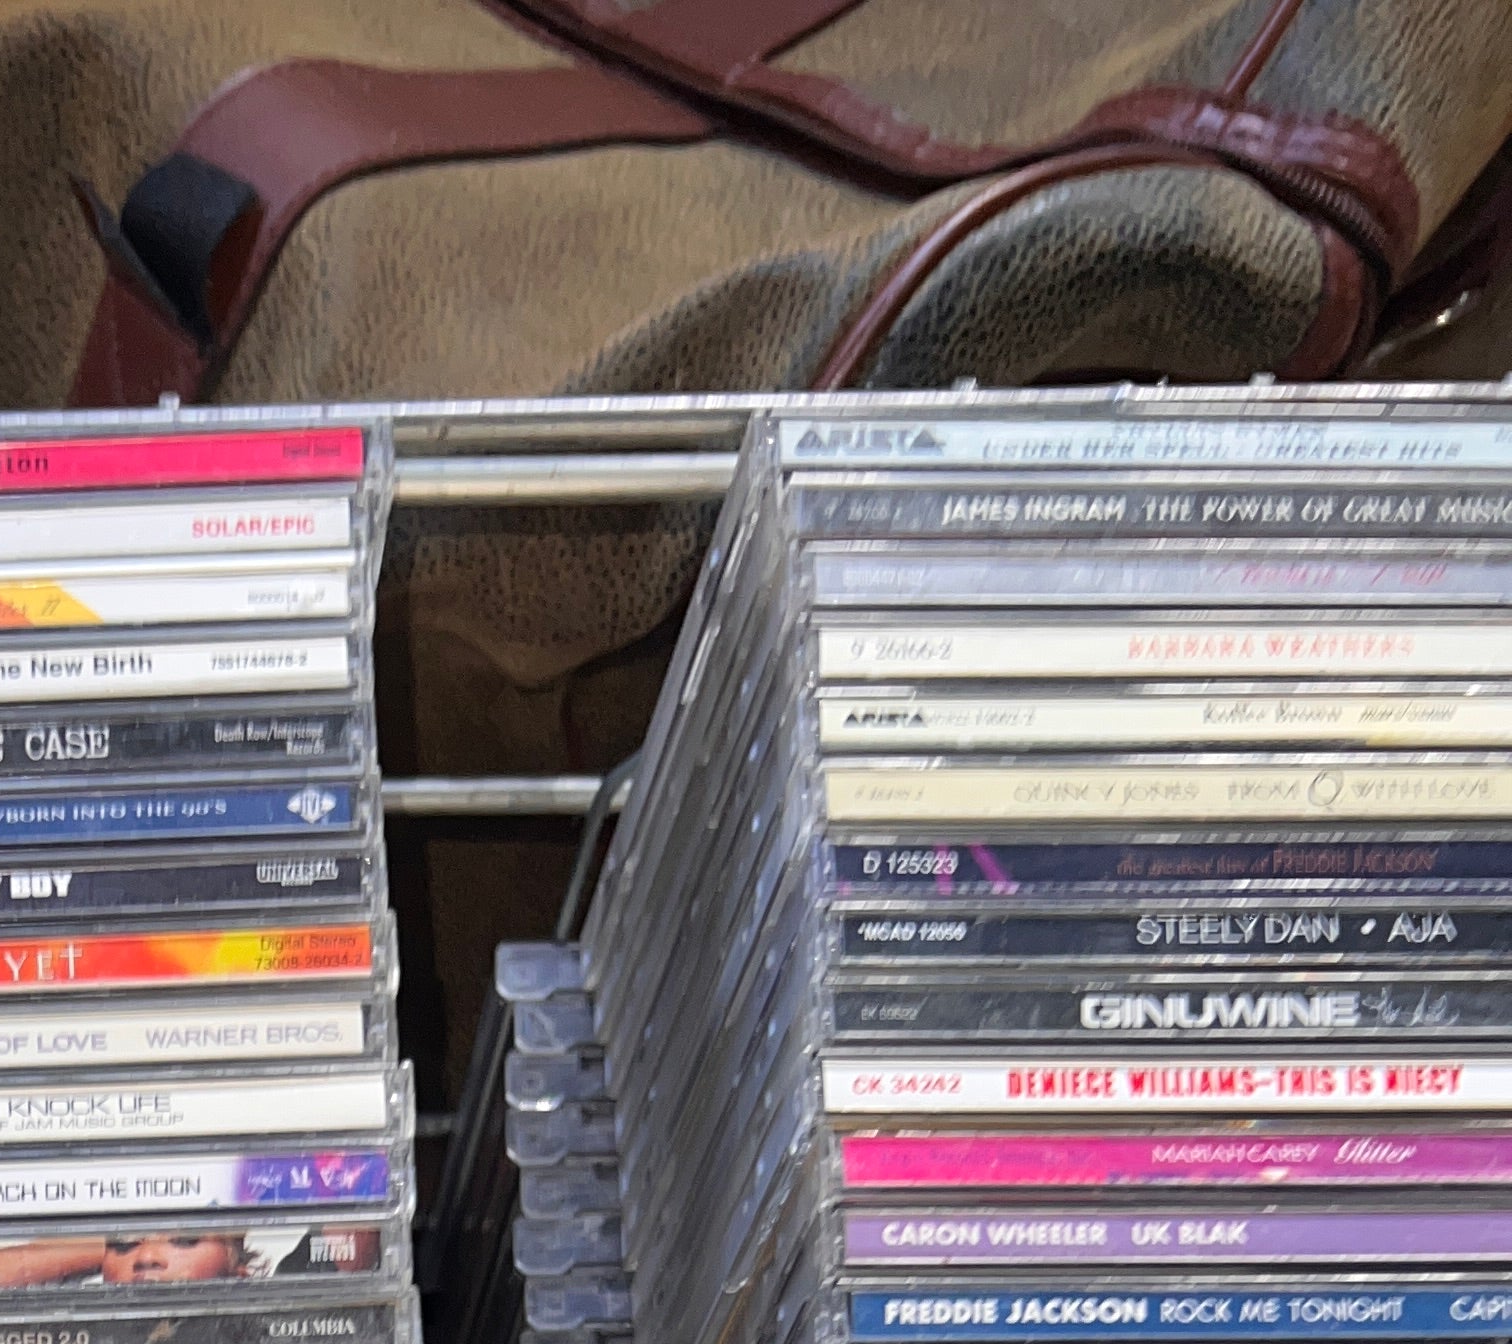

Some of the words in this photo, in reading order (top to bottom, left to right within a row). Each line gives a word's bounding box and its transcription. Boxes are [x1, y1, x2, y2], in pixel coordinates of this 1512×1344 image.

[191, 515, 316, 539] SOLAR/EPIC
[30, 655, 82, 679] New
[93, 652, 153, 676] Birth
[24, 726, 111, 761] CASE
[10, 870, 74, 898] BOY
[1135, 914, 1261, 945] STEELY
[1265, 913, 1340, 944] DAN
[1388, 912, 1458, 944] AJA
[1079, 990, 1361, 1030] GINUWINE
[36, 1032, 108, 1053] LOVE
[881, 1222, 980, 1247] CARON
[987, 1222, 1107, 1246] WHEELER
[1131, 1221, 1172, 1246] UK
[1178, 1221, 1250, 1245] BLAK
[884, 1299, 999, 1325] FREDDIE
[1005, 1299, 1147, 1324] JACKSON
[1160, 1299, 1232, 1323] ROCK
[1239, 1298, 1279, 1323] ME
[1287, 1296, 1406, 1323] TONIGHT
[269, 1319, 356, 1338] COLUMBIA
